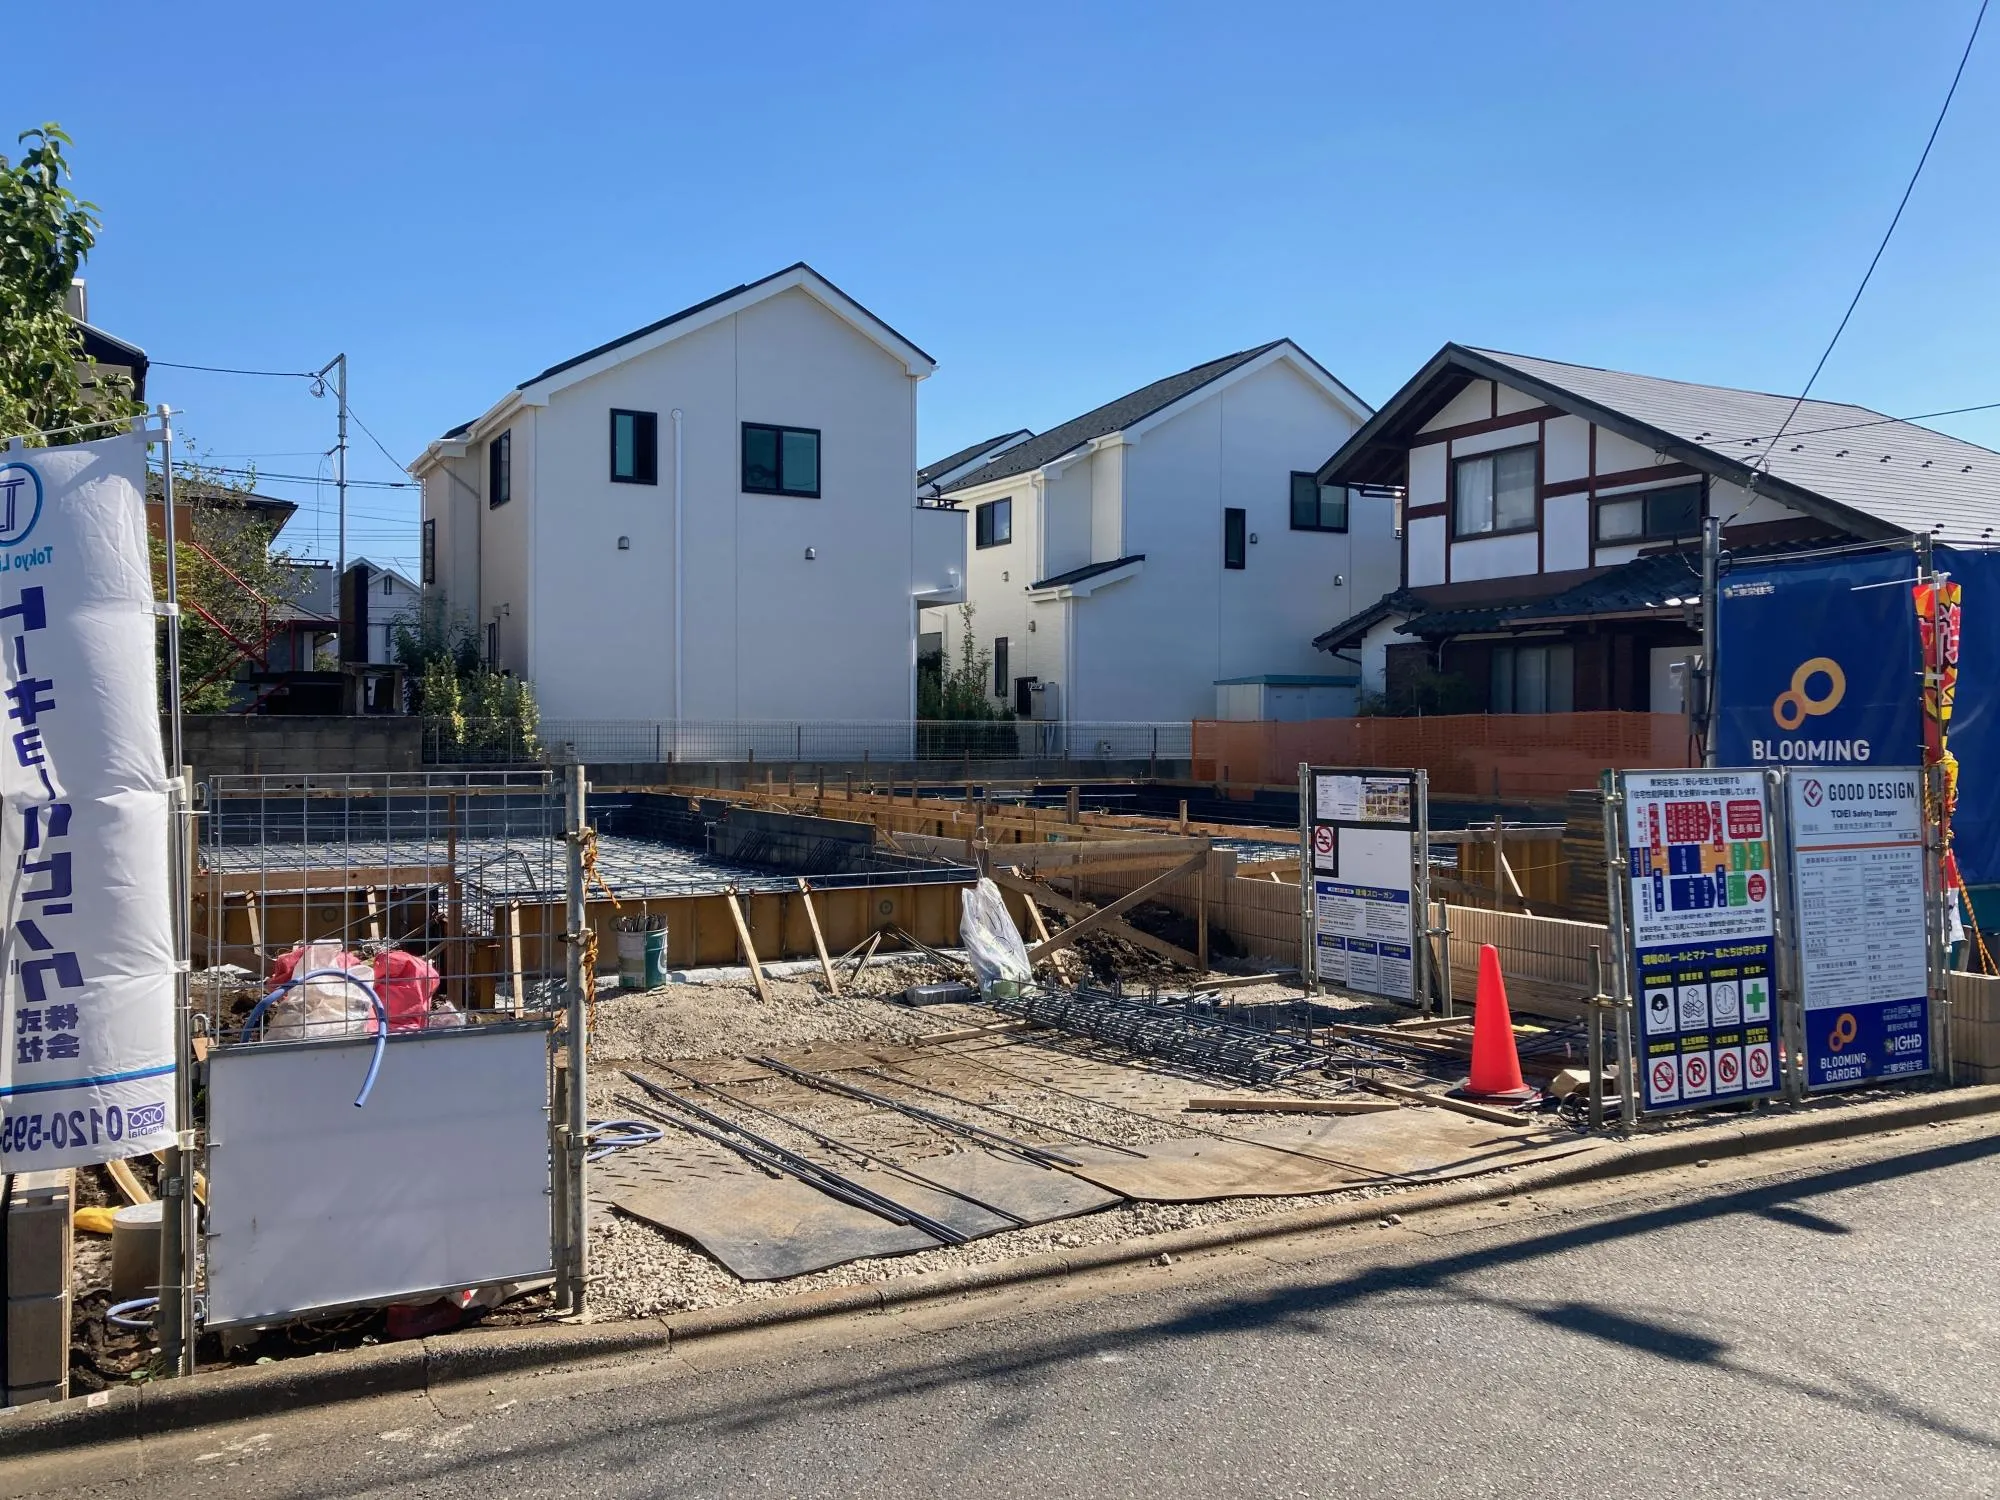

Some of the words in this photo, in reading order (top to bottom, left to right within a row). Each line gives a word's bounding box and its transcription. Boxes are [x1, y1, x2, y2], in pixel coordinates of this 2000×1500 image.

[1752, 739, 1870, 762] BLOOMING
[1828, 783, 1864, 801] GOOD
[1869, 781, 1915, 800] DESIGN
[1853, 809, 1873, 818] Safety
[1874, 809, 1898, 817] Damper
[1820, 1053, 1867, 1069] BLOOMING
[1826, 1066, 1862, 1081] GARDEN
